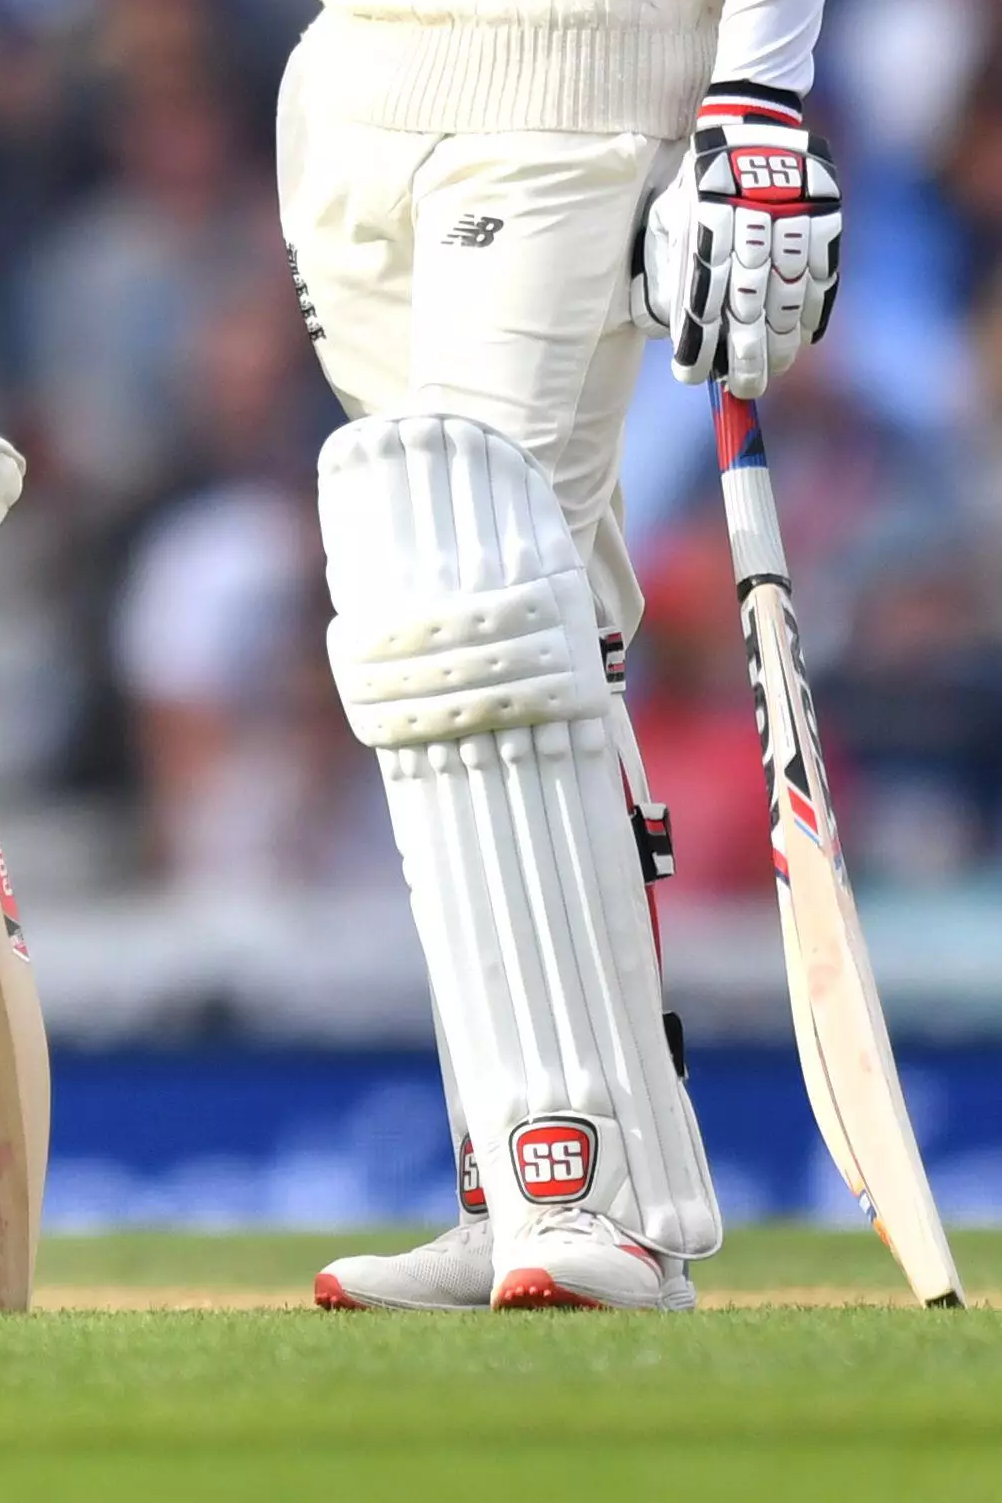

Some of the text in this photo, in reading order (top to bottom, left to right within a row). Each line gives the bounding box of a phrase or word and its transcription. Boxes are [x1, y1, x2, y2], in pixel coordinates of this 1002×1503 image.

[737, 155, 802, 189] SS
[463, 1152, 480, 1192] S
[522, 1140, 585, 1184] SS
